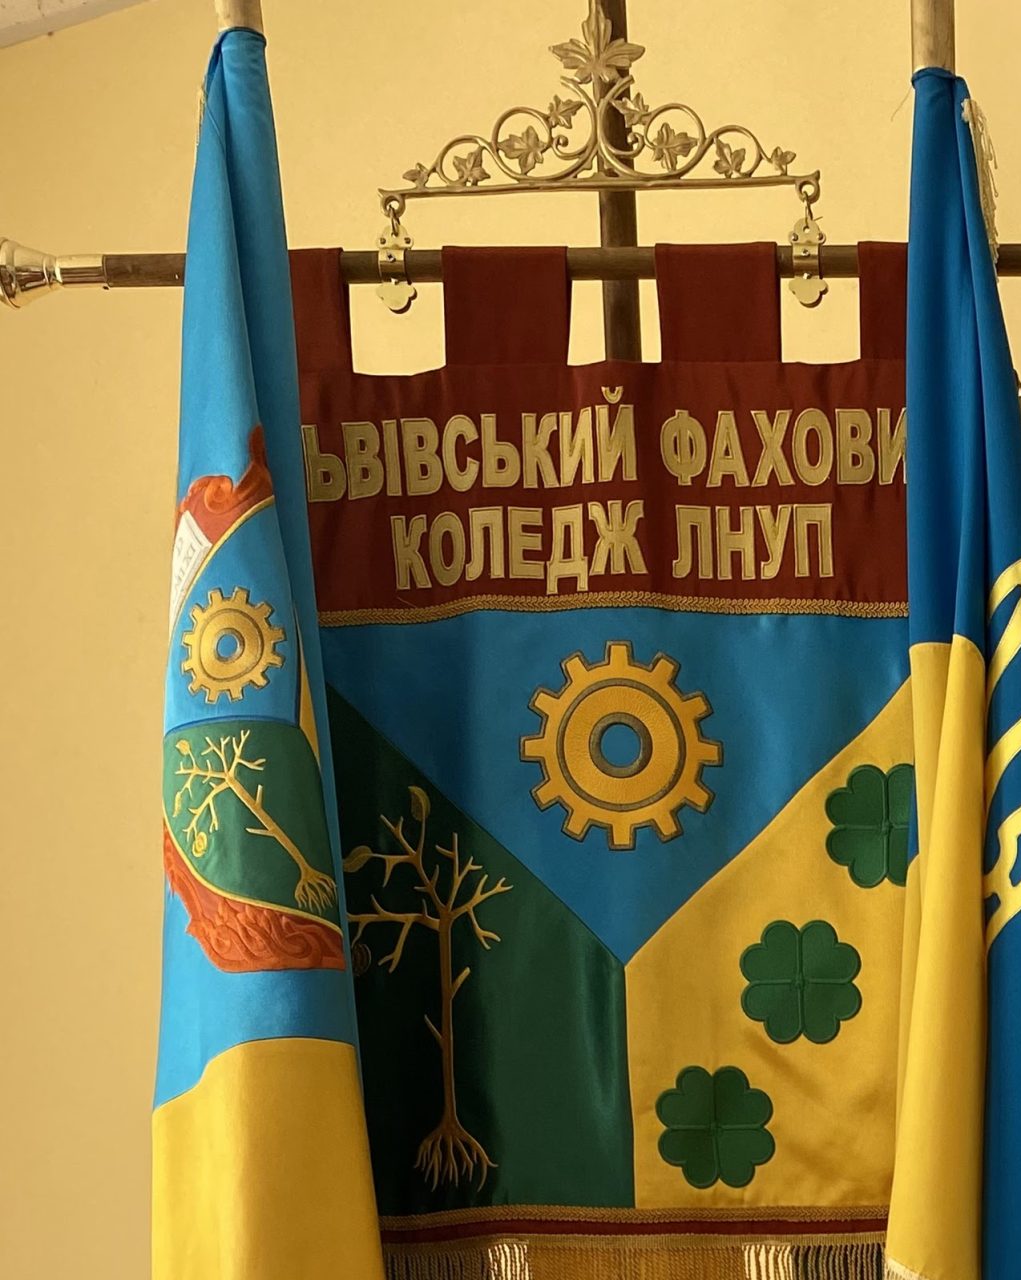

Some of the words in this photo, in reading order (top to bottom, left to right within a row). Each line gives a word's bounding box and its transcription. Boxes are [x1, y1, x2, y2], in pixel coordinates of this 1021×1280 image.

[301, 386, 637, 502] ЬВІВСЬКИЙ
[660, 408, 907, 486] ФАХОВИ
[391, 500, 648, 594] КОЛЕДЖ
[672, 503, 834, 580] ЛНУП
